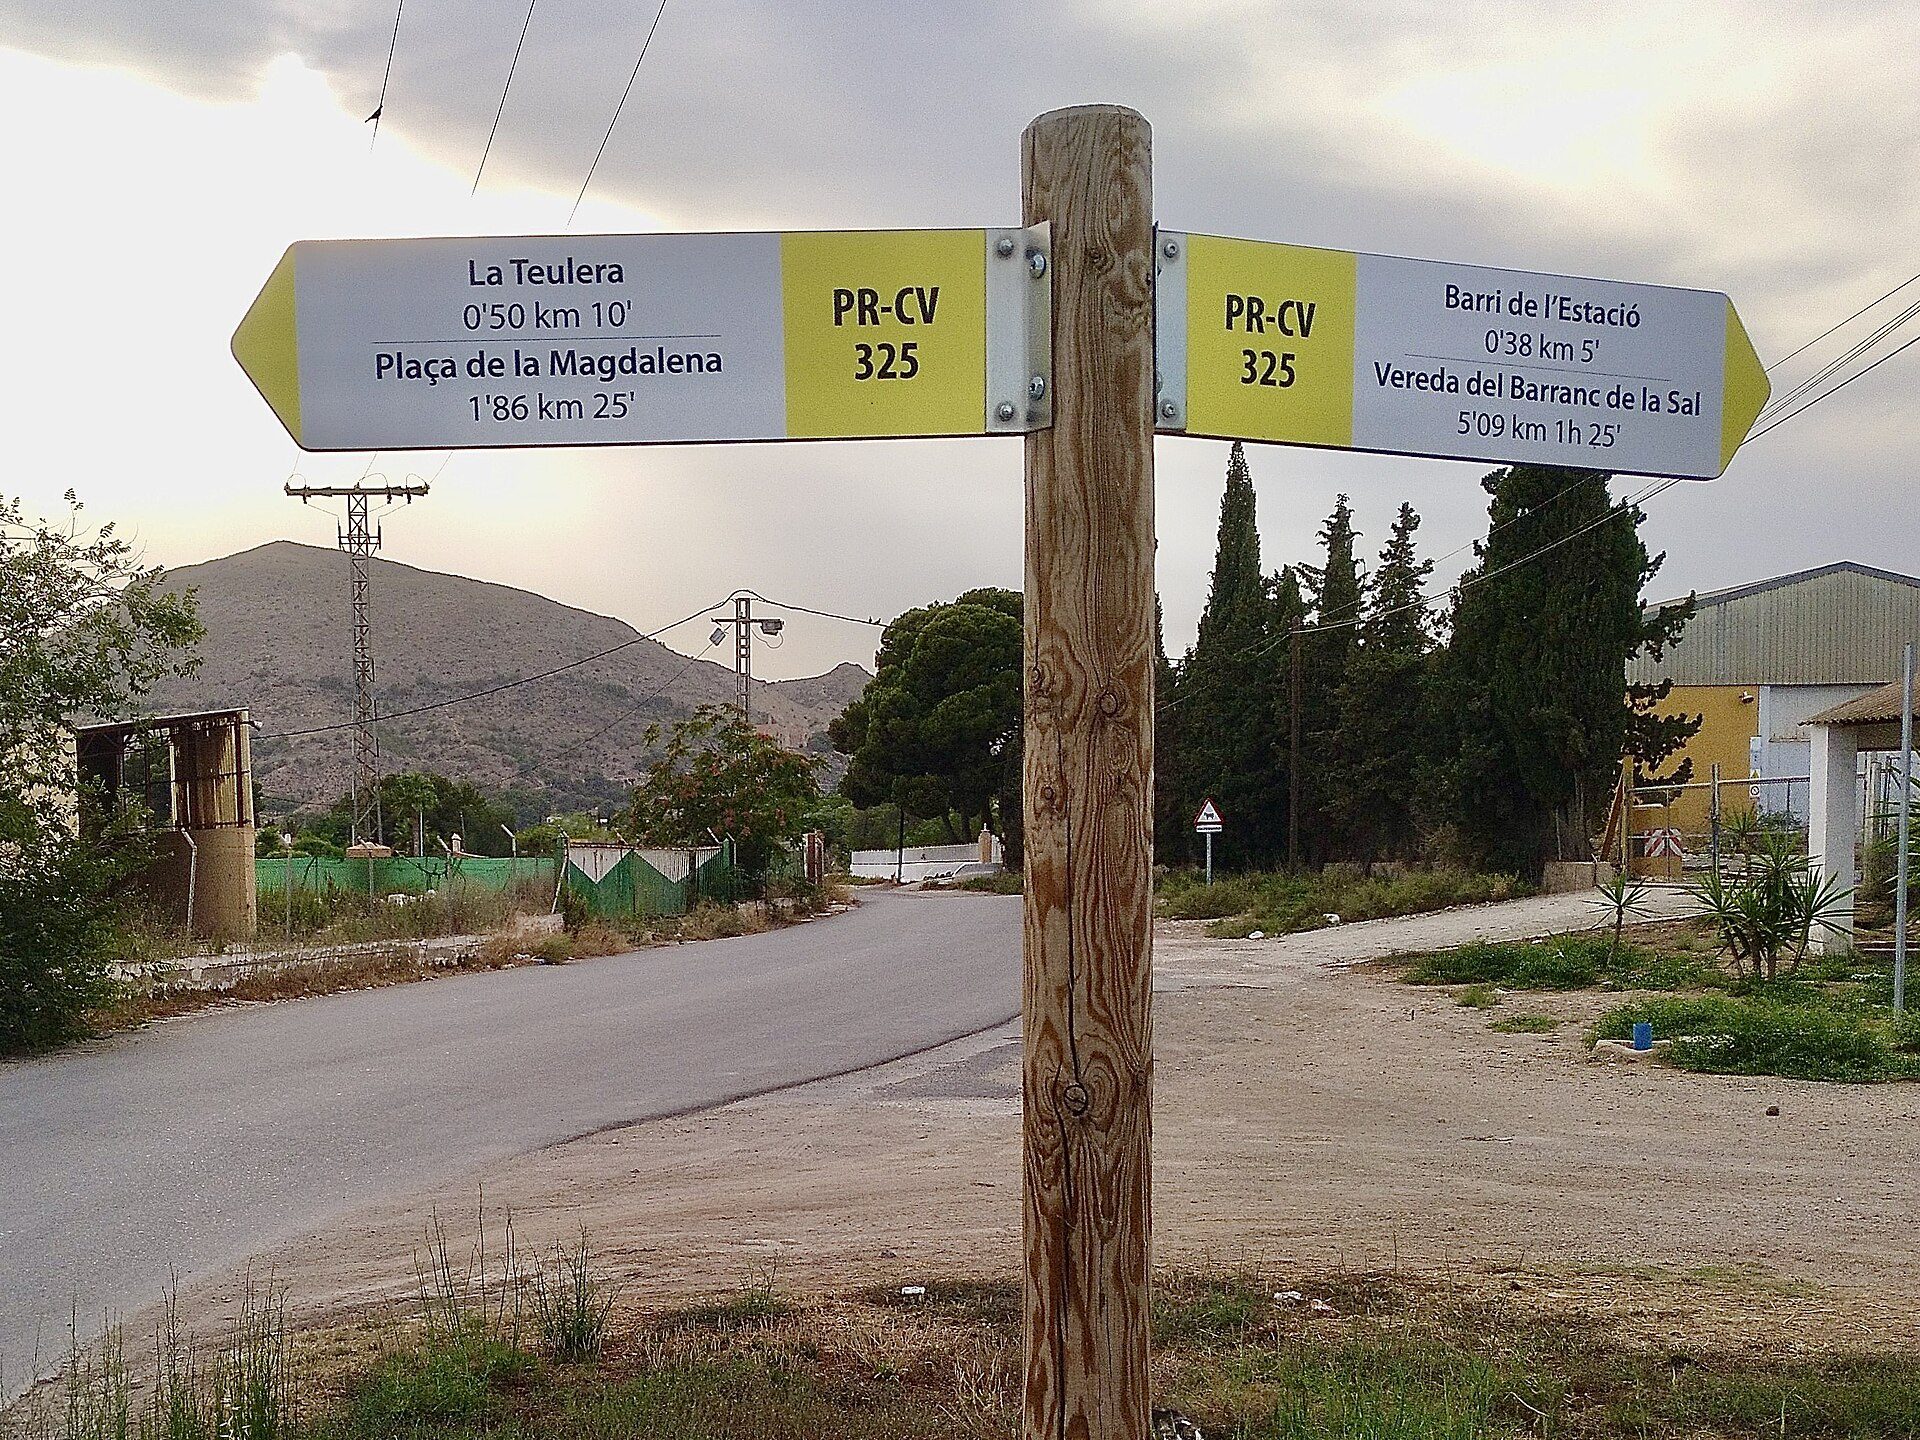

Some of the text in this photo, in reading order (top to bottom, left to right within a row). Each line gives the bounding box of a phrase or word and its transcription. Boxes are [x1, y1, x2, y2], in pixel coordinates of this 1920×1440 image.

[470, 257, 623, 286] La Teulera
[464, 300, 632, 330] 0'50 km 10'
[834, 287, 939, 327] PR-CV
[1226, 295, 1316, 338] PR-CV
[1446, 285, 1501, 314] Barri
[1509, 291, 1538, 318] de
[855, 343, 918, 381] 325
[1486, 329, 1600, 363] 0'38 km 5'
[376, 346, 722, 387] Plaça de la Magdalena
[1241, 350, 1296, 388] 325
[470, 392, 635, 422] 1'86 km 25'
[1374, 361, 1701, 416] Vereda del Barranc de la Sal
[1458, 410, 1622, 448] 5'09 km 1h 25'
